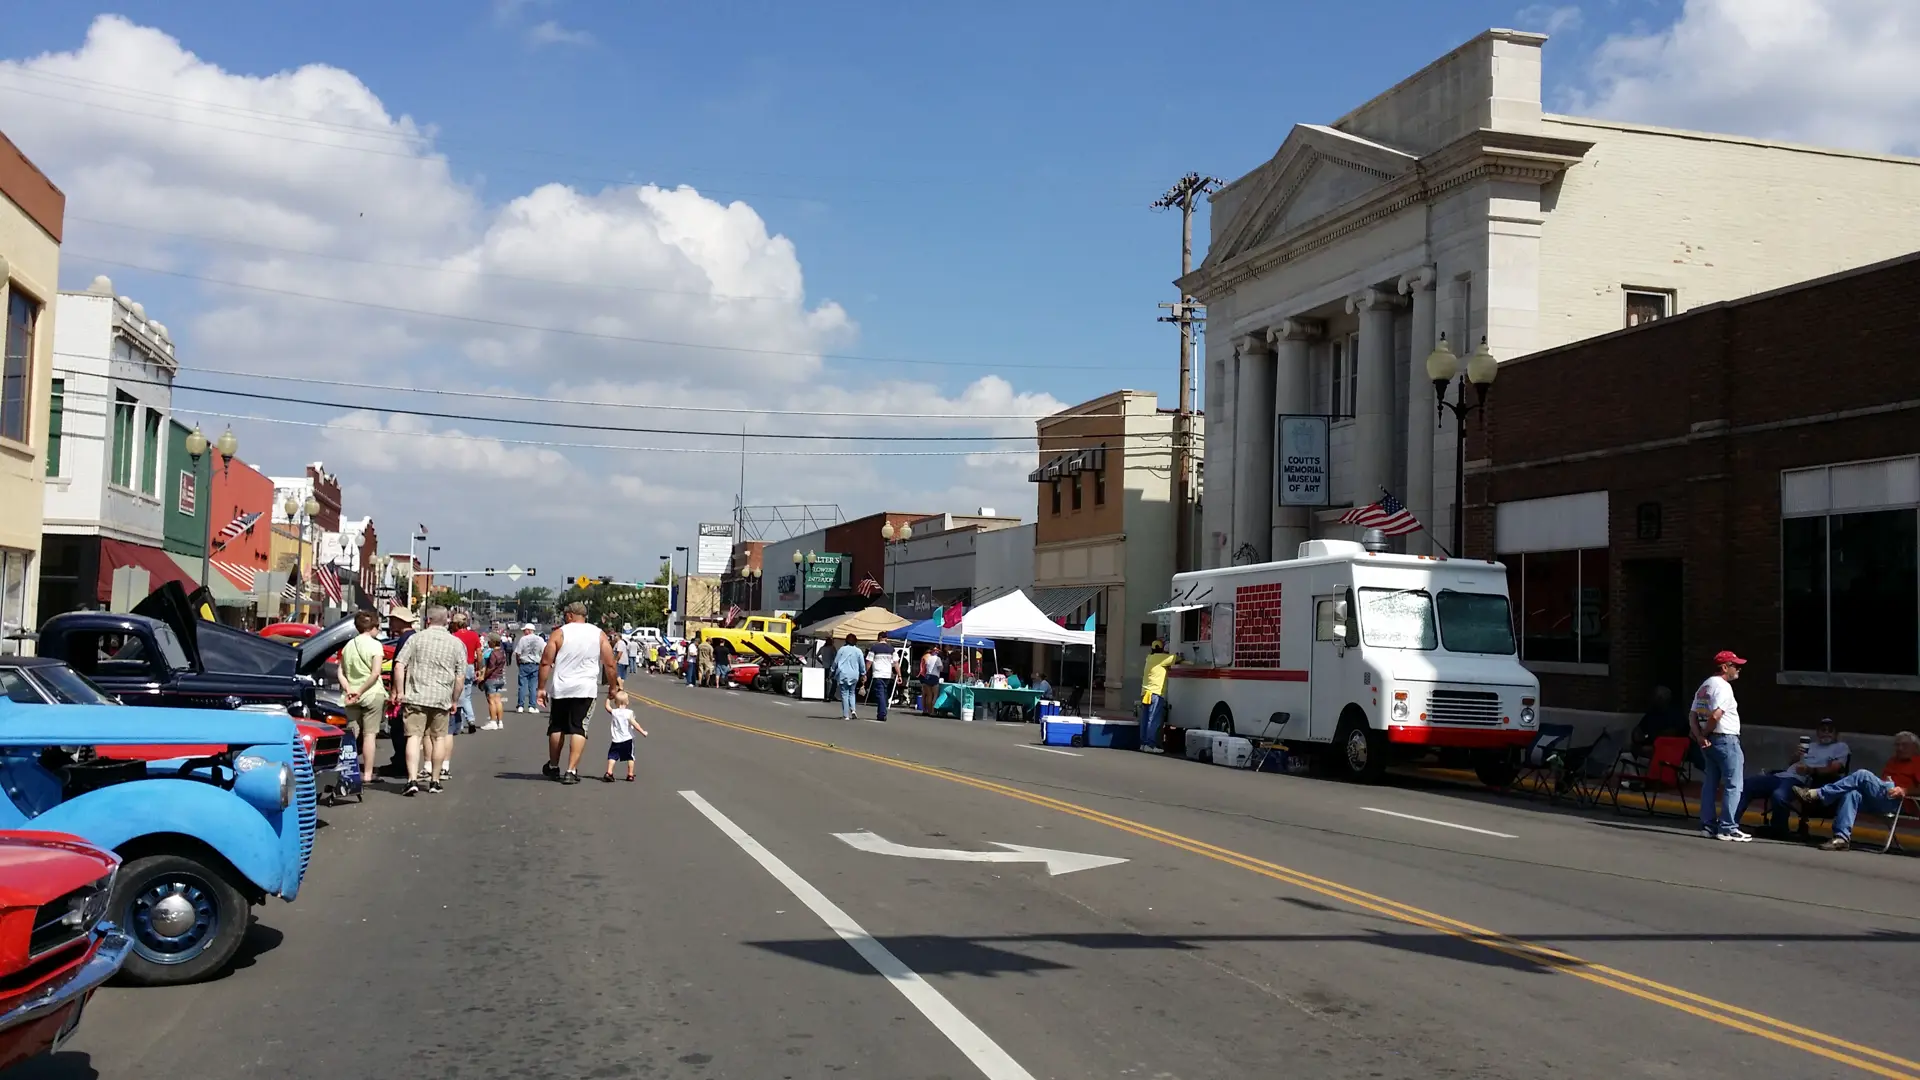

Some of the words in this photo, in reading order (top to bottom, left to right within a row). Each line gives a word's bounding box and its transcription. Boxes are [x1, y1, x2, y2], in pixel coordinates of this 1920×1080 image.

[1288, 456, 1320, 465] COUTTS
[1284, 465, 1324, 474] MEMORIAL
[1287, 474, 1321, 483] MUSEUM
[1289, 484, 1300, 493] OF
[1304, 484, 1320, 493] ART
